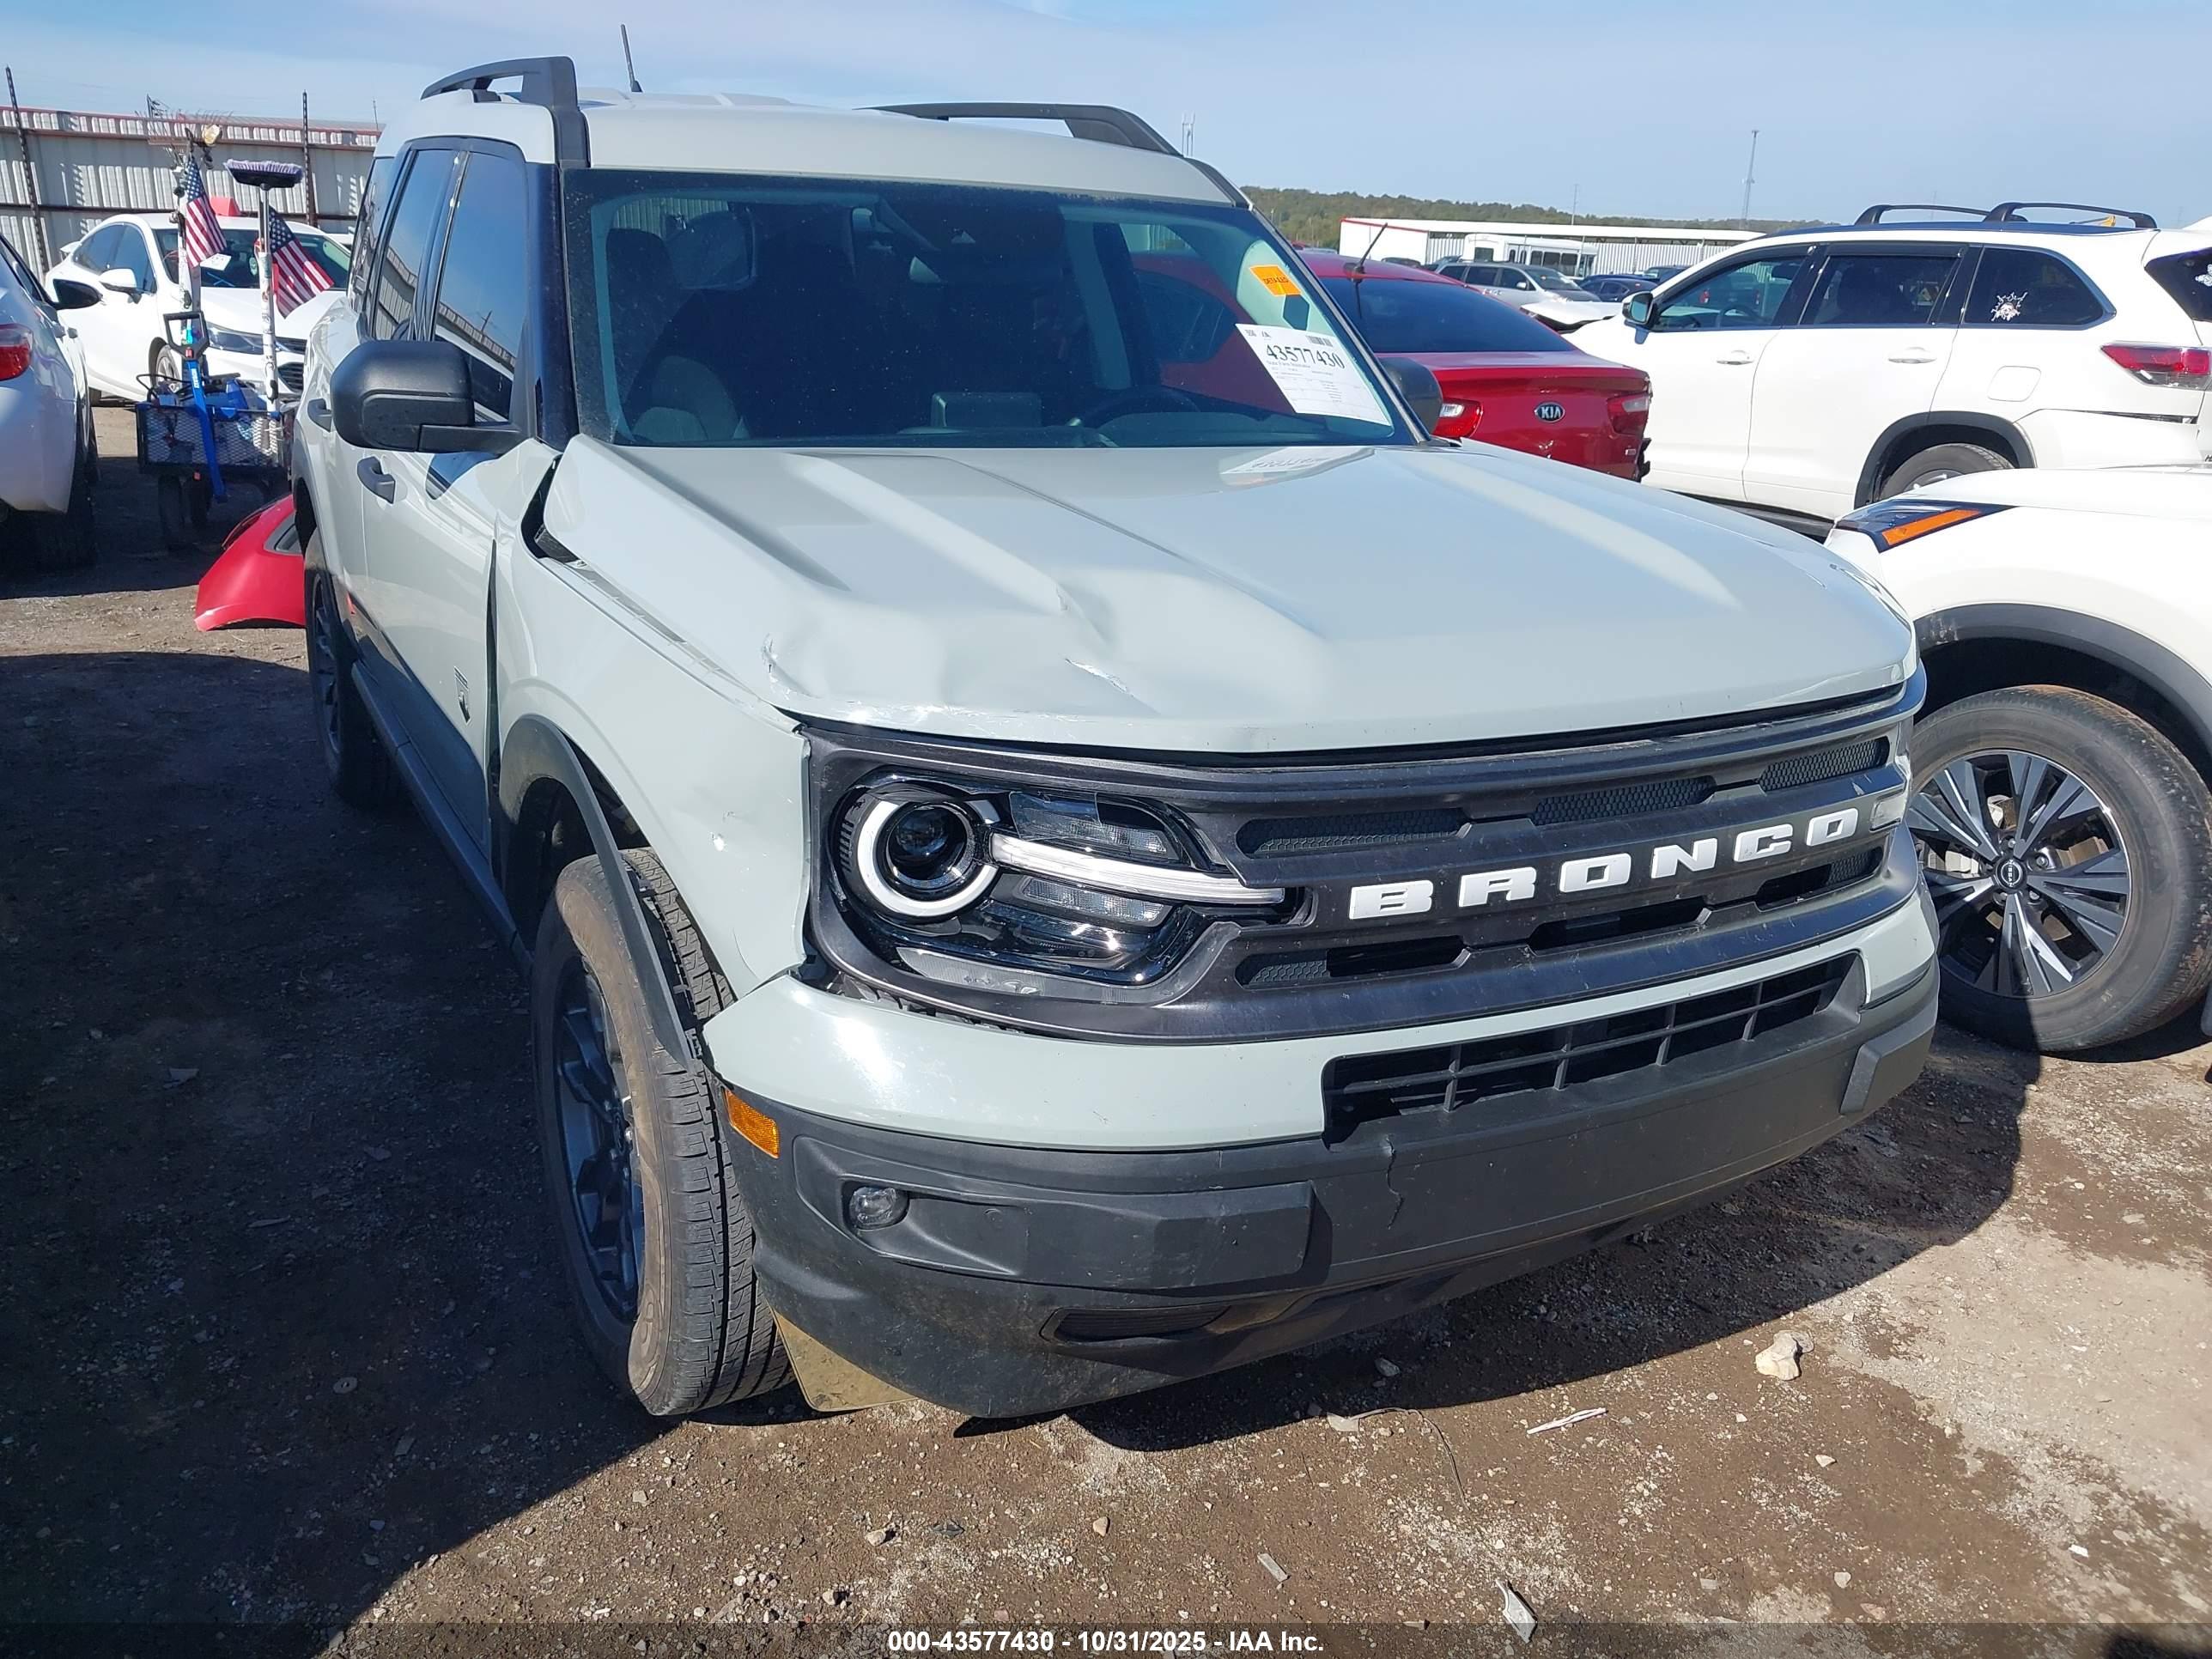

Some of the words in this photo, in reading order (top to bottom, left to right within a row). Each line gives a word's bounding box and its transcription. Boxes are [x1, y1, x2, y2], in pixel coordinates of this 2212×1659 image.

[1266, 344, 1346, 369] 43577430
[1540, 405, 1561, 419] KIA
[1349, 807, 1858, 920] BRONCO
